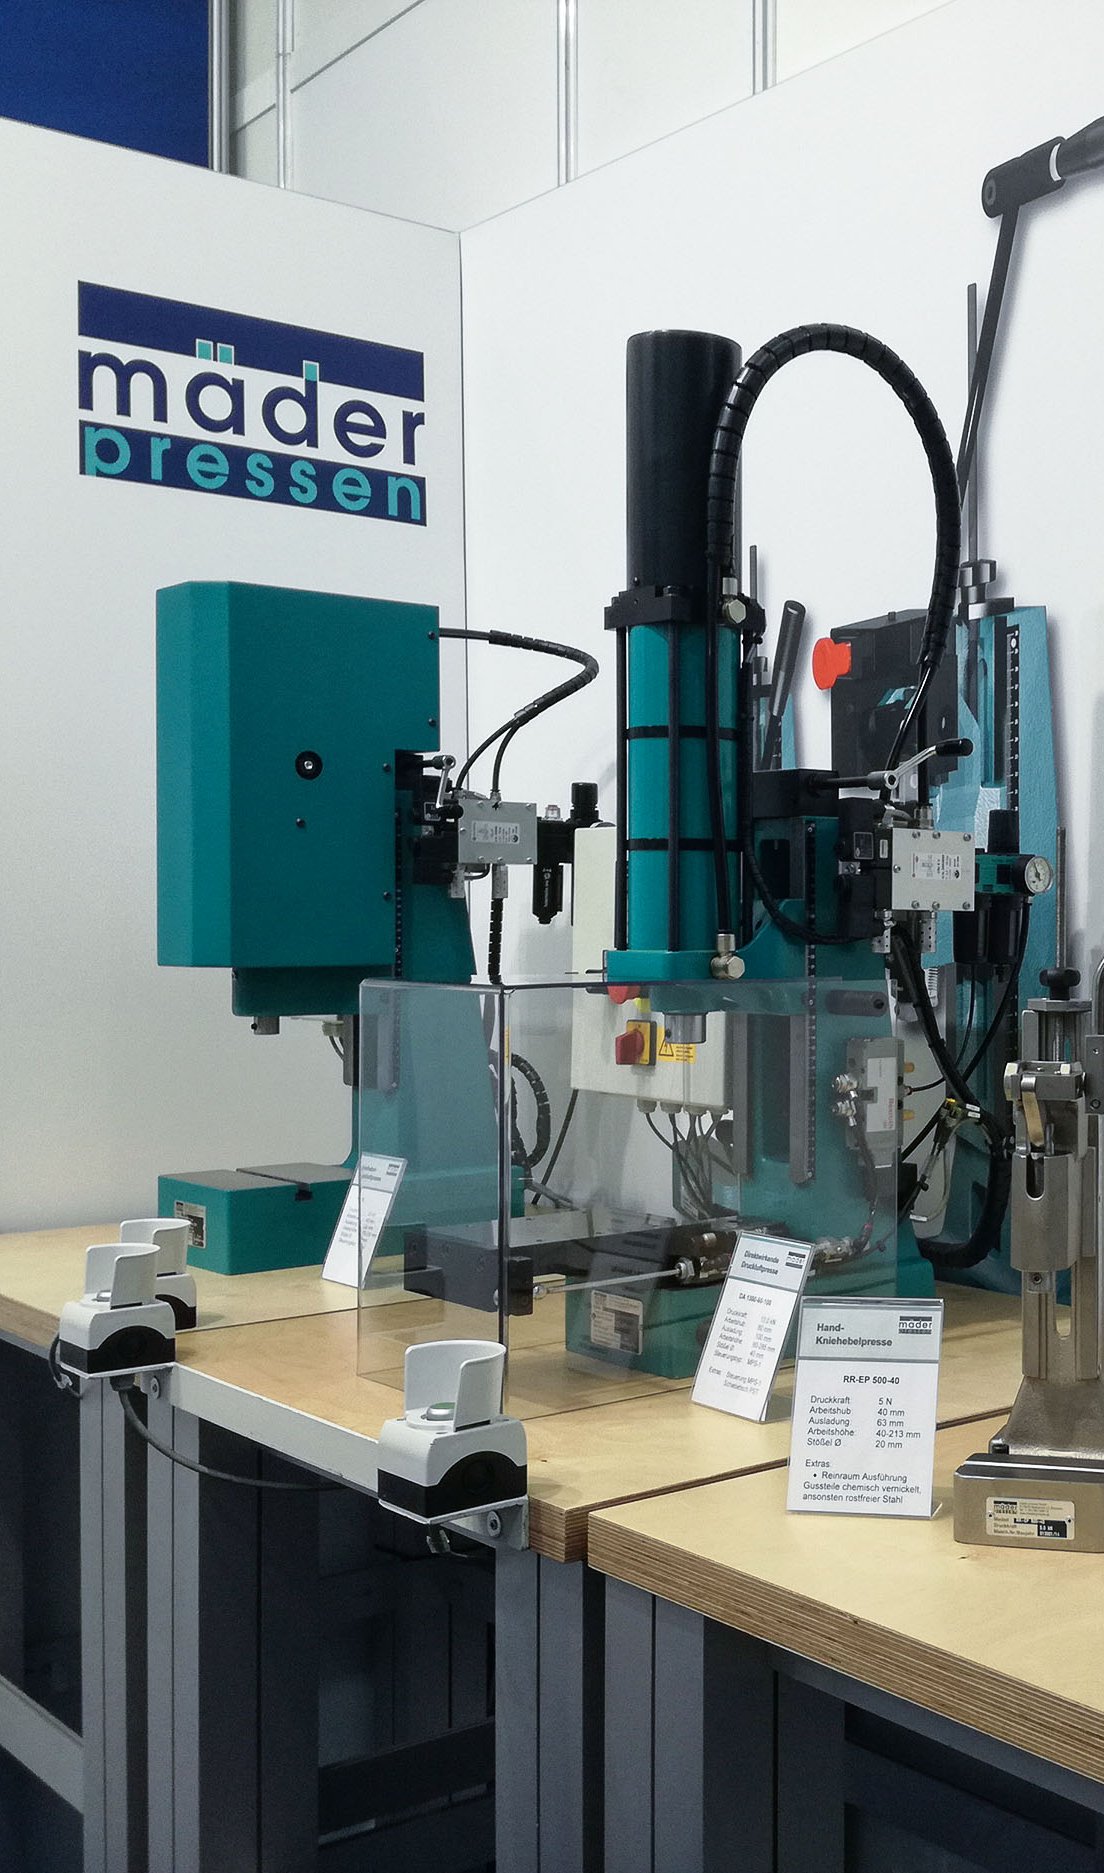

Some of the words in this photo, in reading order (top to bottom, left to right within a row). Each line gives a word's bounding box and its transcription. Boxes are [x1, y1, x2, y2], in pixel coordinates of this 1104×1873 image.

[78, 338, 426, 466] mäder
[84, 426, 422, 521] pressen
[817, 1323, 845, 1332] Hand-
[898, 1319, 933, 1329] mäder
[815, 1336, 893, 1347] Kniehebelpresse
[843, 1375, 871, 1384] RR-EP
[872, 1376, 900, 1385] 500-40
[877, 1408, 888, 1416] 40
[876, 1419, 887, 1427] 63
[875, 1429, 904, 1438] 40-213
[807, 1437, 833, 1447] Stößel
[875, 1440, 886, 1448] 20
[821, 1471, 860, 1480] Reinraum
[862, 1472, 908, 1484] Ausführung
[803, 1481, 840, 1491] Gussteile
[842, 1483, 880, 1492] chemisch
[802, 1493, 844, 1501] ansonsten
[845, 1494, 880, 1503] rostfreier
[882, 1495, 903, 1504] Stahl
